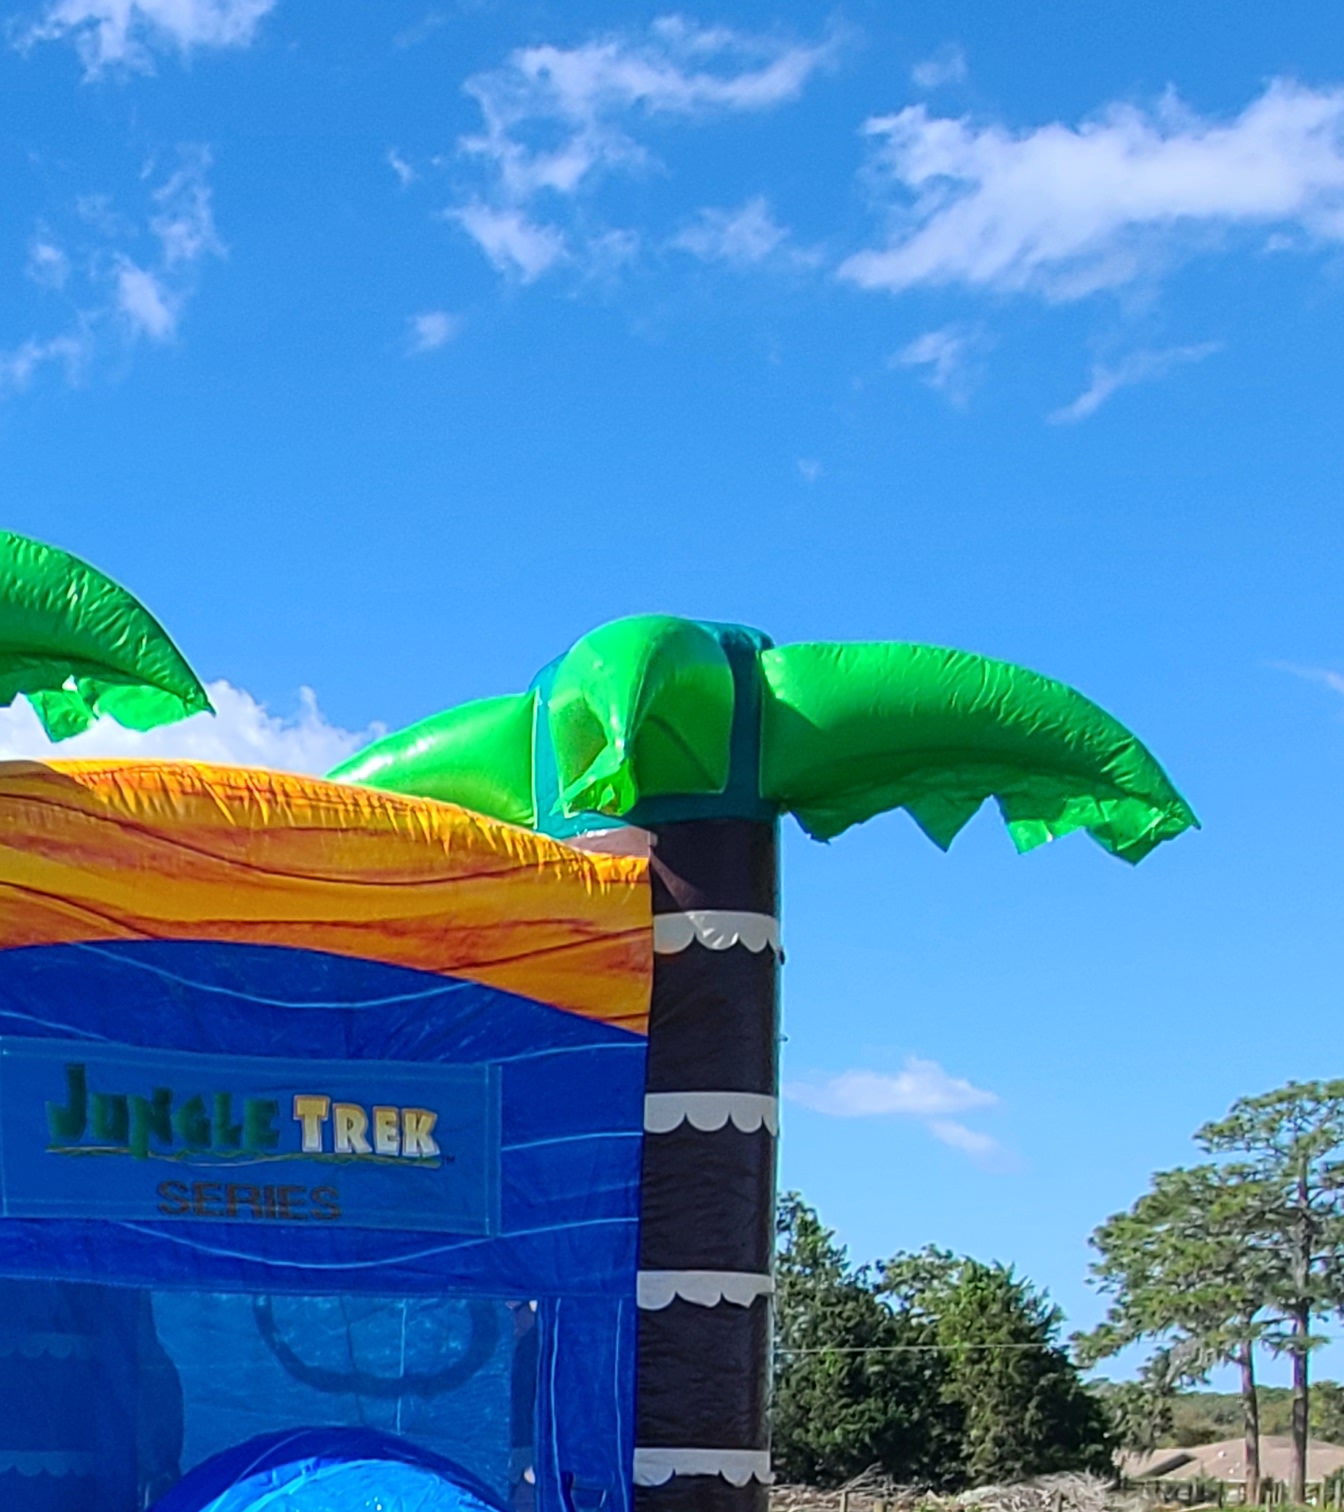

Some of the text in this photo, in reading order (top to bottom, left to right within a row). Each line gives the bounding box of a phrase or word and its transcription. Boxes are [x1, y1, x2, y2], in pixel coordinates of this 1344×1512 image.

[44, 1062, 280, 1160] JUNGLE
[292, 1093, 441, 1157] TREK
[155, 1179, 342, 1221] SERIES
